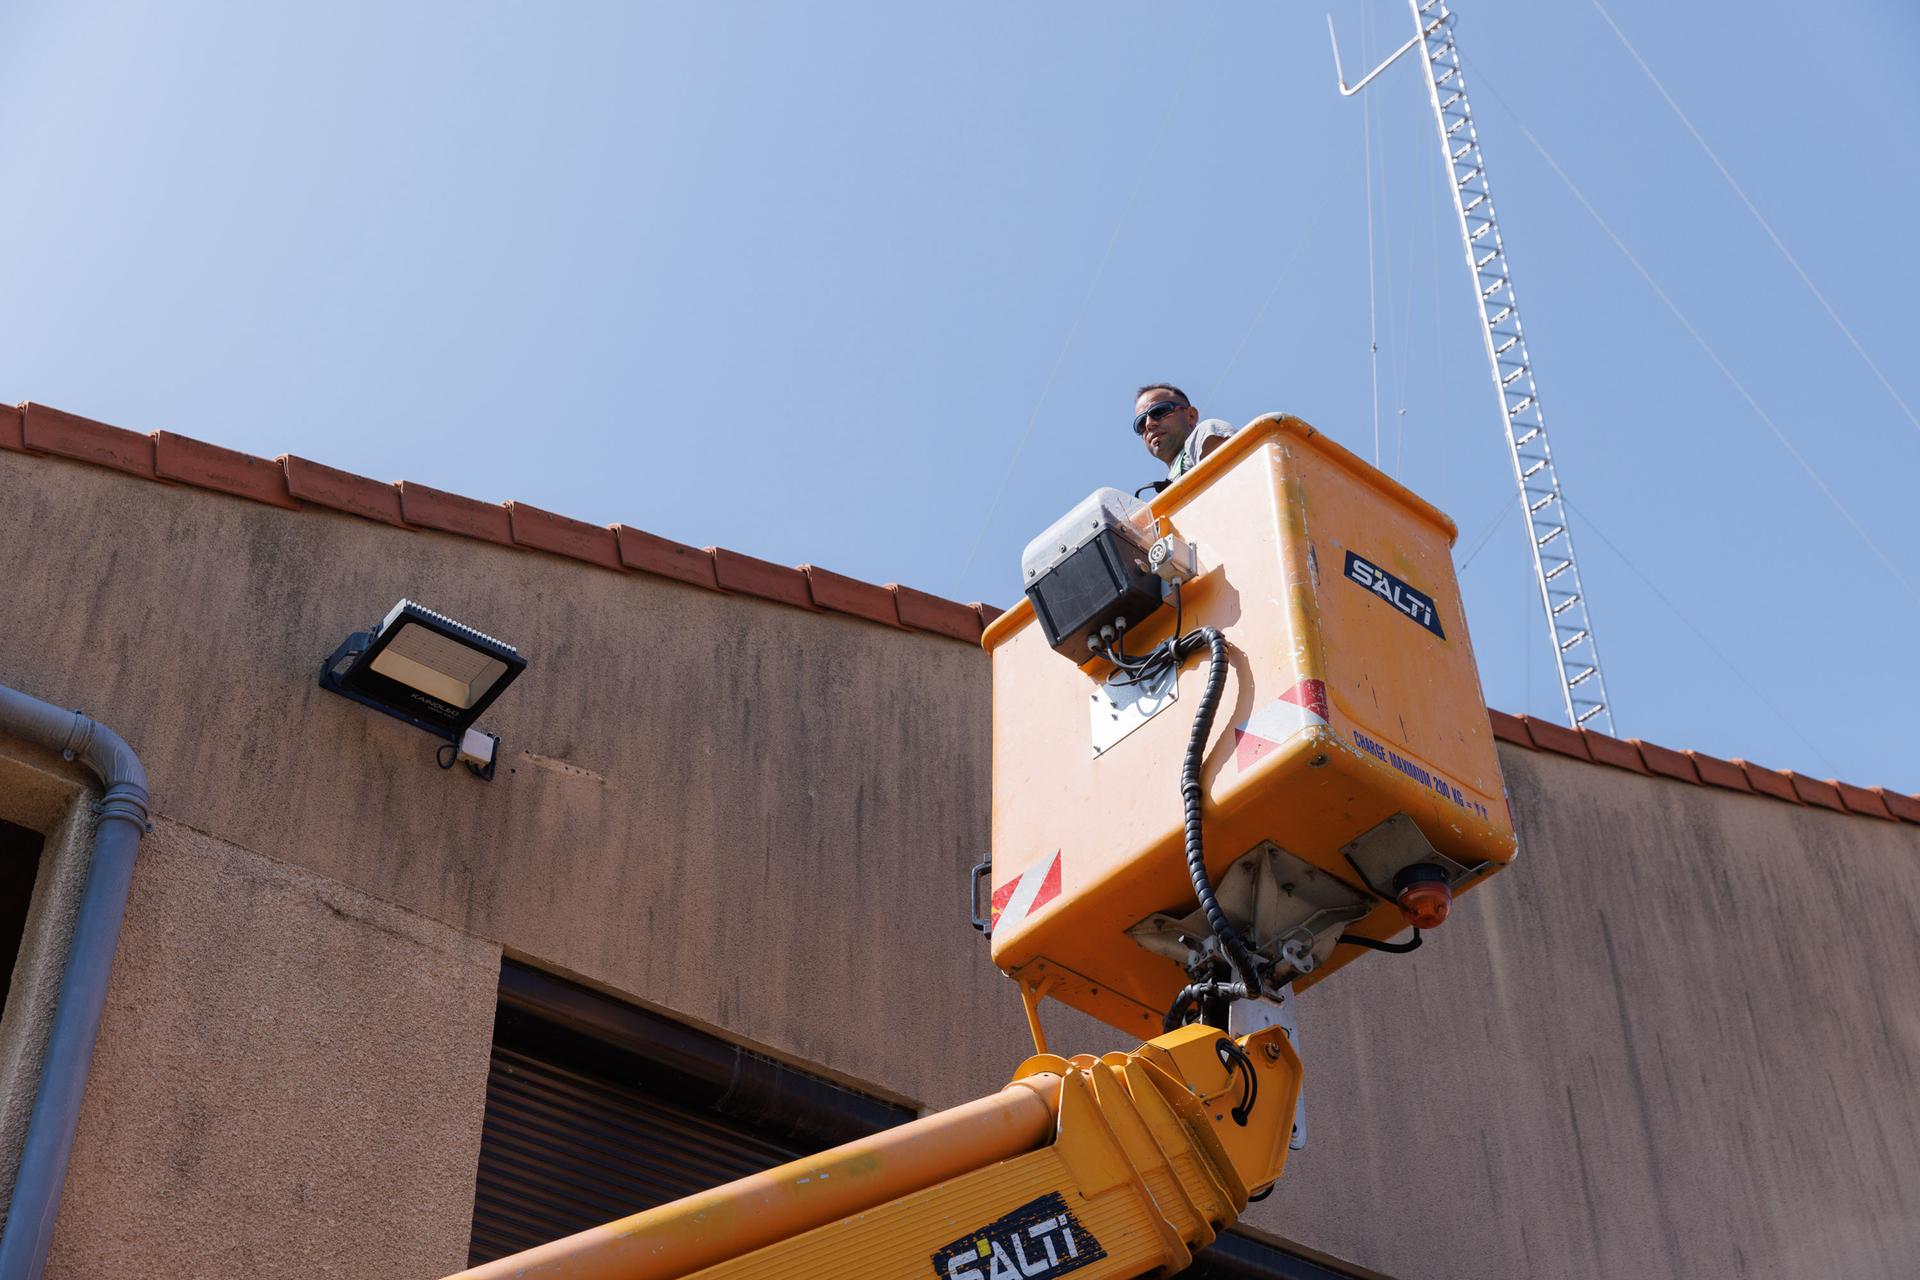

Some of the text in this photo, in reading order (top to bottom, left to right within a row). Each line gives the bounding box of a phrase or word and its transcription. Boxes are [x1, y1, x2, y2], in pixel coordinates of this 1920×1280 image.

[1353, 730, 1388, 763] CHARGE
[1388, 751, 1433, 789] MAXIMUM
[1433, 775, 1451, 800] 200
[1451, 786, 1465, 808] KG
